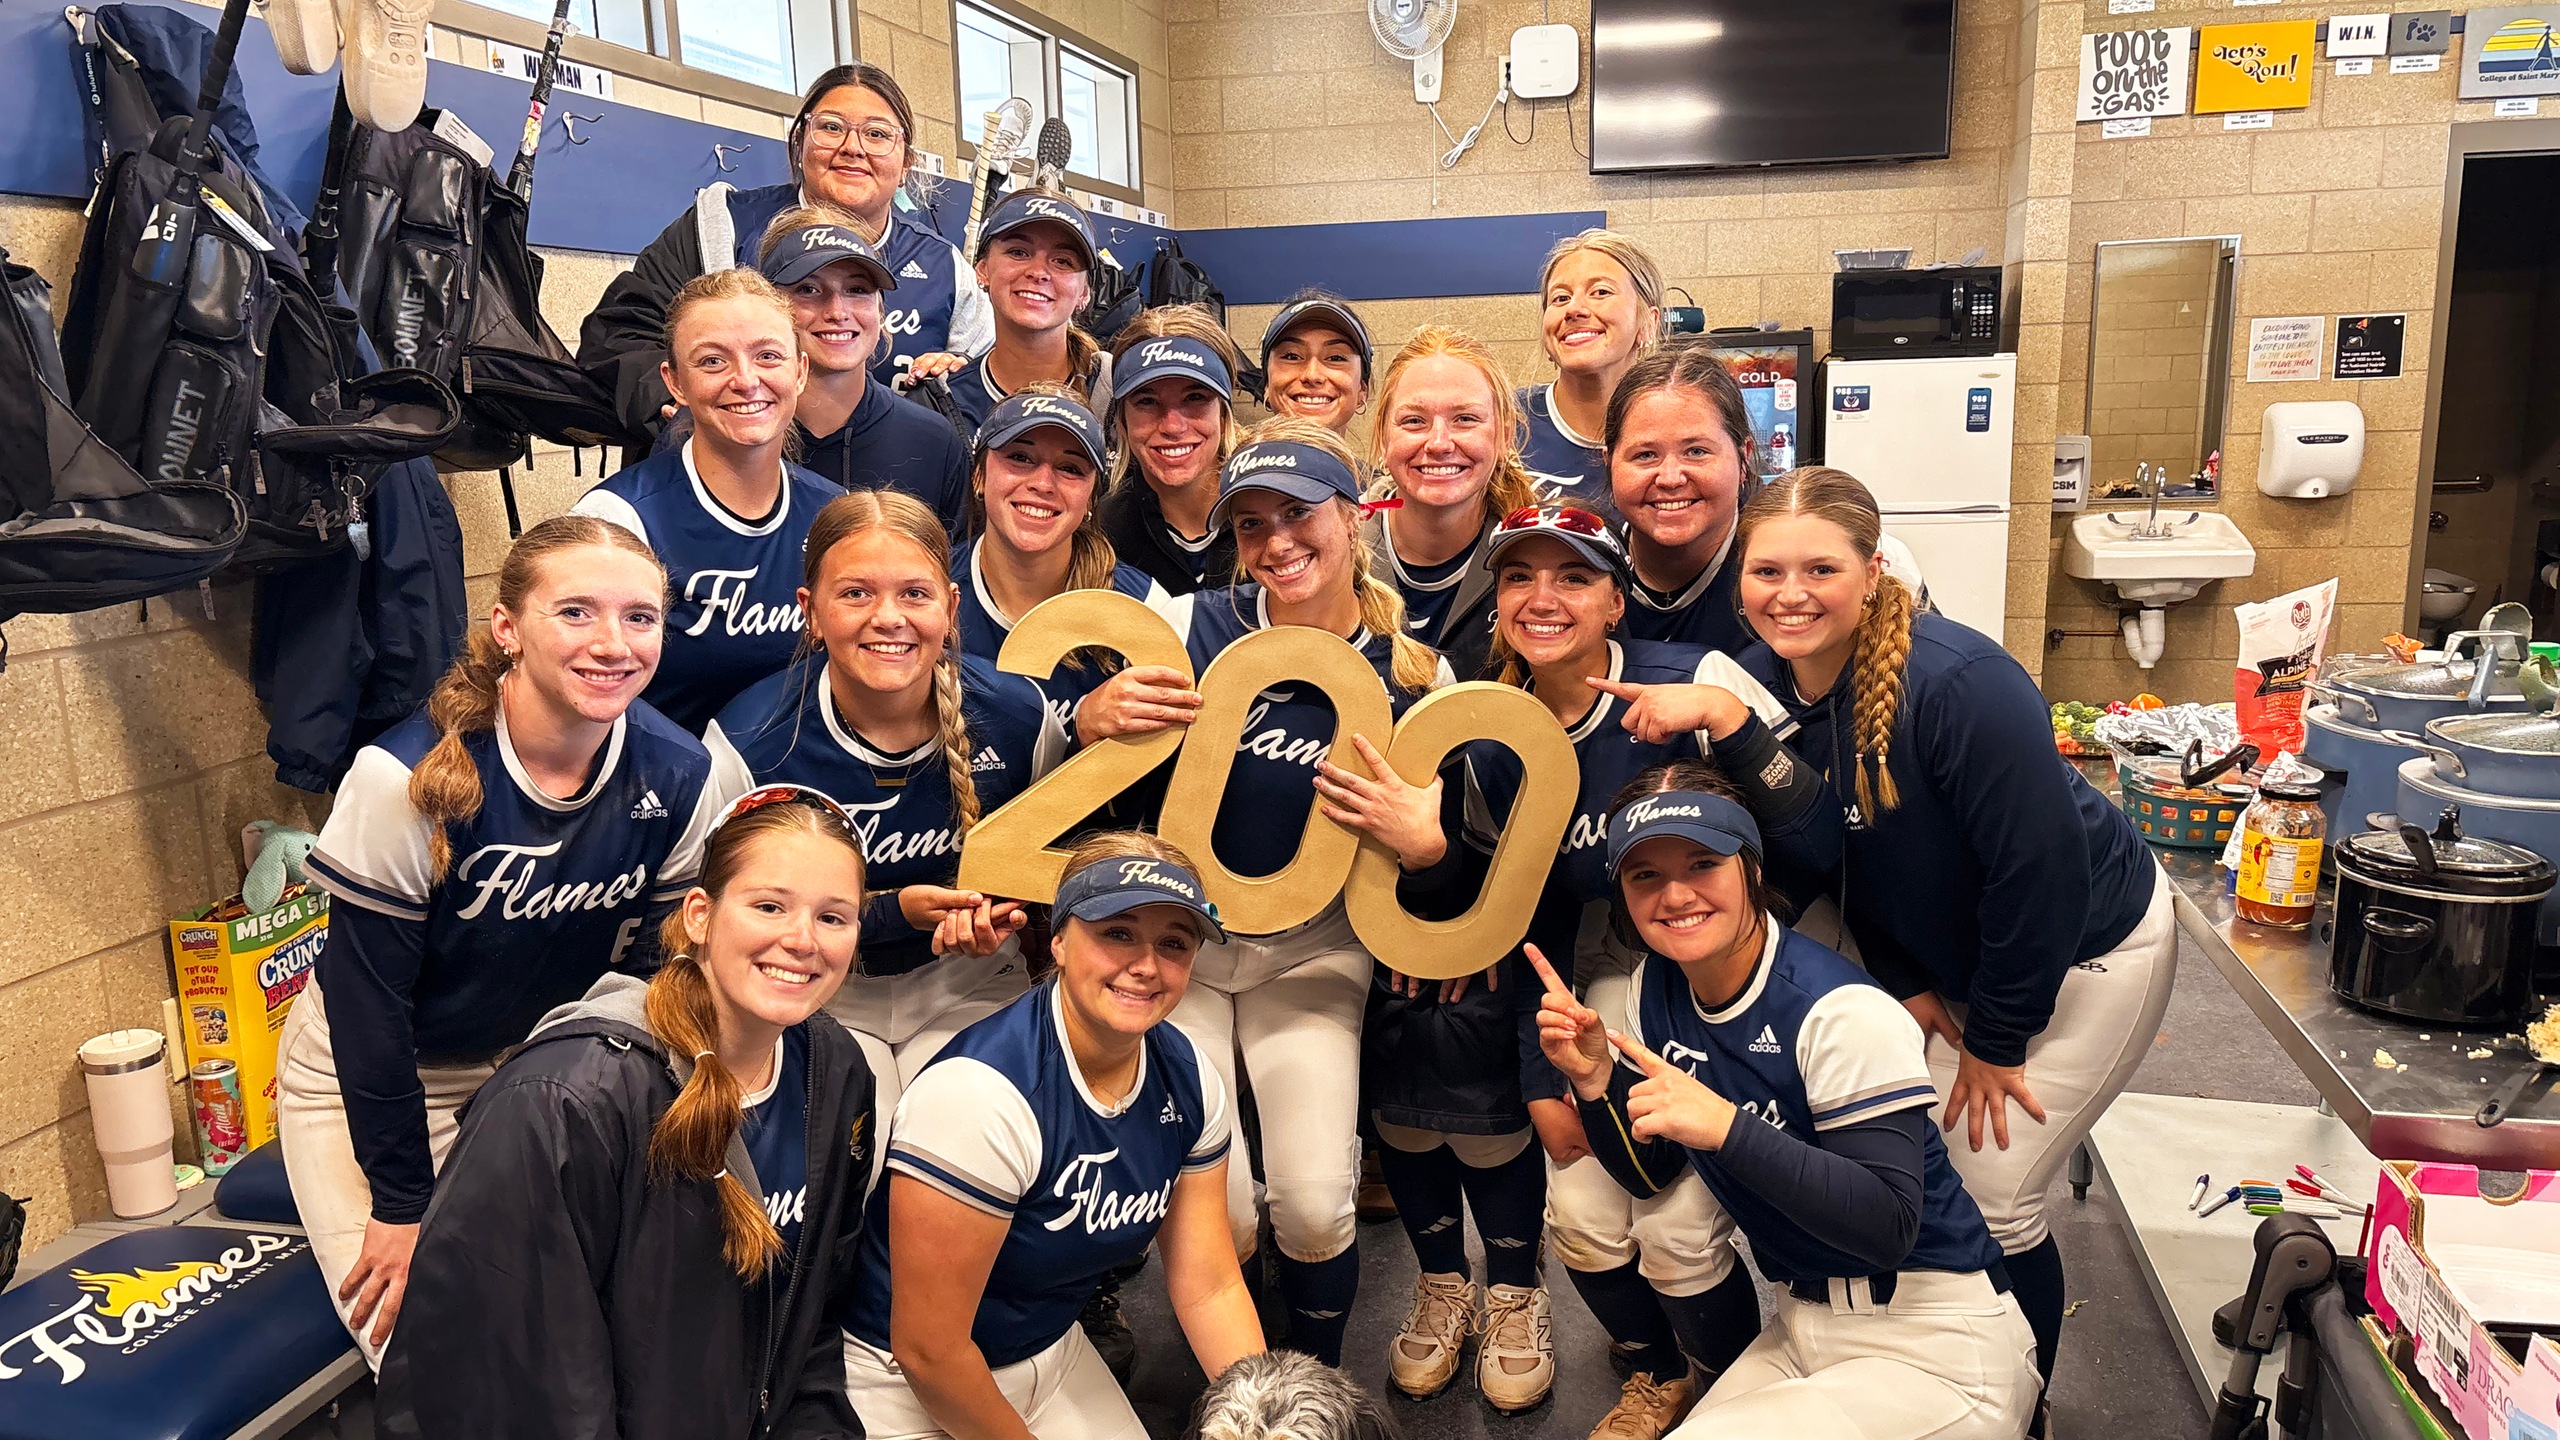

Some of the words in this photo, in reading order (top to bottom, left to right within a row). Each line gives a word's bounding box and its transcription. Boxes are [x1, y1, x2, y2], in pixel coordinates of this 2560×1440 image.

[85, 52, 96, 93] lululemon
[596, 73, 603, 95] 1
[2132, 59, 2168, 87] the
[2479, 73, 2507, 83] College
[2508, 73, 2517, 82] of
[2517, 72, 2539, 82] Saint
[2103, 91, 2156, 115] GAS
[1026, 198, 1083, 233] Flames
[802, 227, 866, 256] Flames
[1141, 339, 1205, 369] Flames
[1738, 371, 1782, 384] COLD
[1835, 387, 1852, 396] 988
[1021, 396, 1087, 430] Flames
[1971, 394, 1988, 403] 988
[157, 378, 207, 480] OWNET
[1229, 445, 1297, 484] Flames
[2052, 480, 2077, 490] CSM
[684, 564, 808, 637] Flam
[2271, 662, 2308, 679] ALPINE
[957, 589, 1580, 980] 200
[1764, 757, 1788, 784] ZONE
[1626, 796, 1702, 833] Flames
[457, 839, 647, 920] Flames
[1118, 860, 1195, 899] Flames
[235, 903, 303, 942] MEGA
[306, 891, 330, 916] SIZ
[179, 928, 219, 943] CRUNCH
[184, 965, 200, 976] TRY
[200, 964, 220, 976] OUR
[190, 974, 216, 986] OTHER
[184, 986, 228, 999] PRODUCTS!
[1043, 1146, 1180, 1235] Flame
[0, 1235, 290, 1385] Flames
[121, 1307, 199, 1355] COLLEGE
[200, 1291, 223, 1306] OF
[226, 1261, 274, 1290] SAINT
[274, 1241, 310, 1261] MAR
